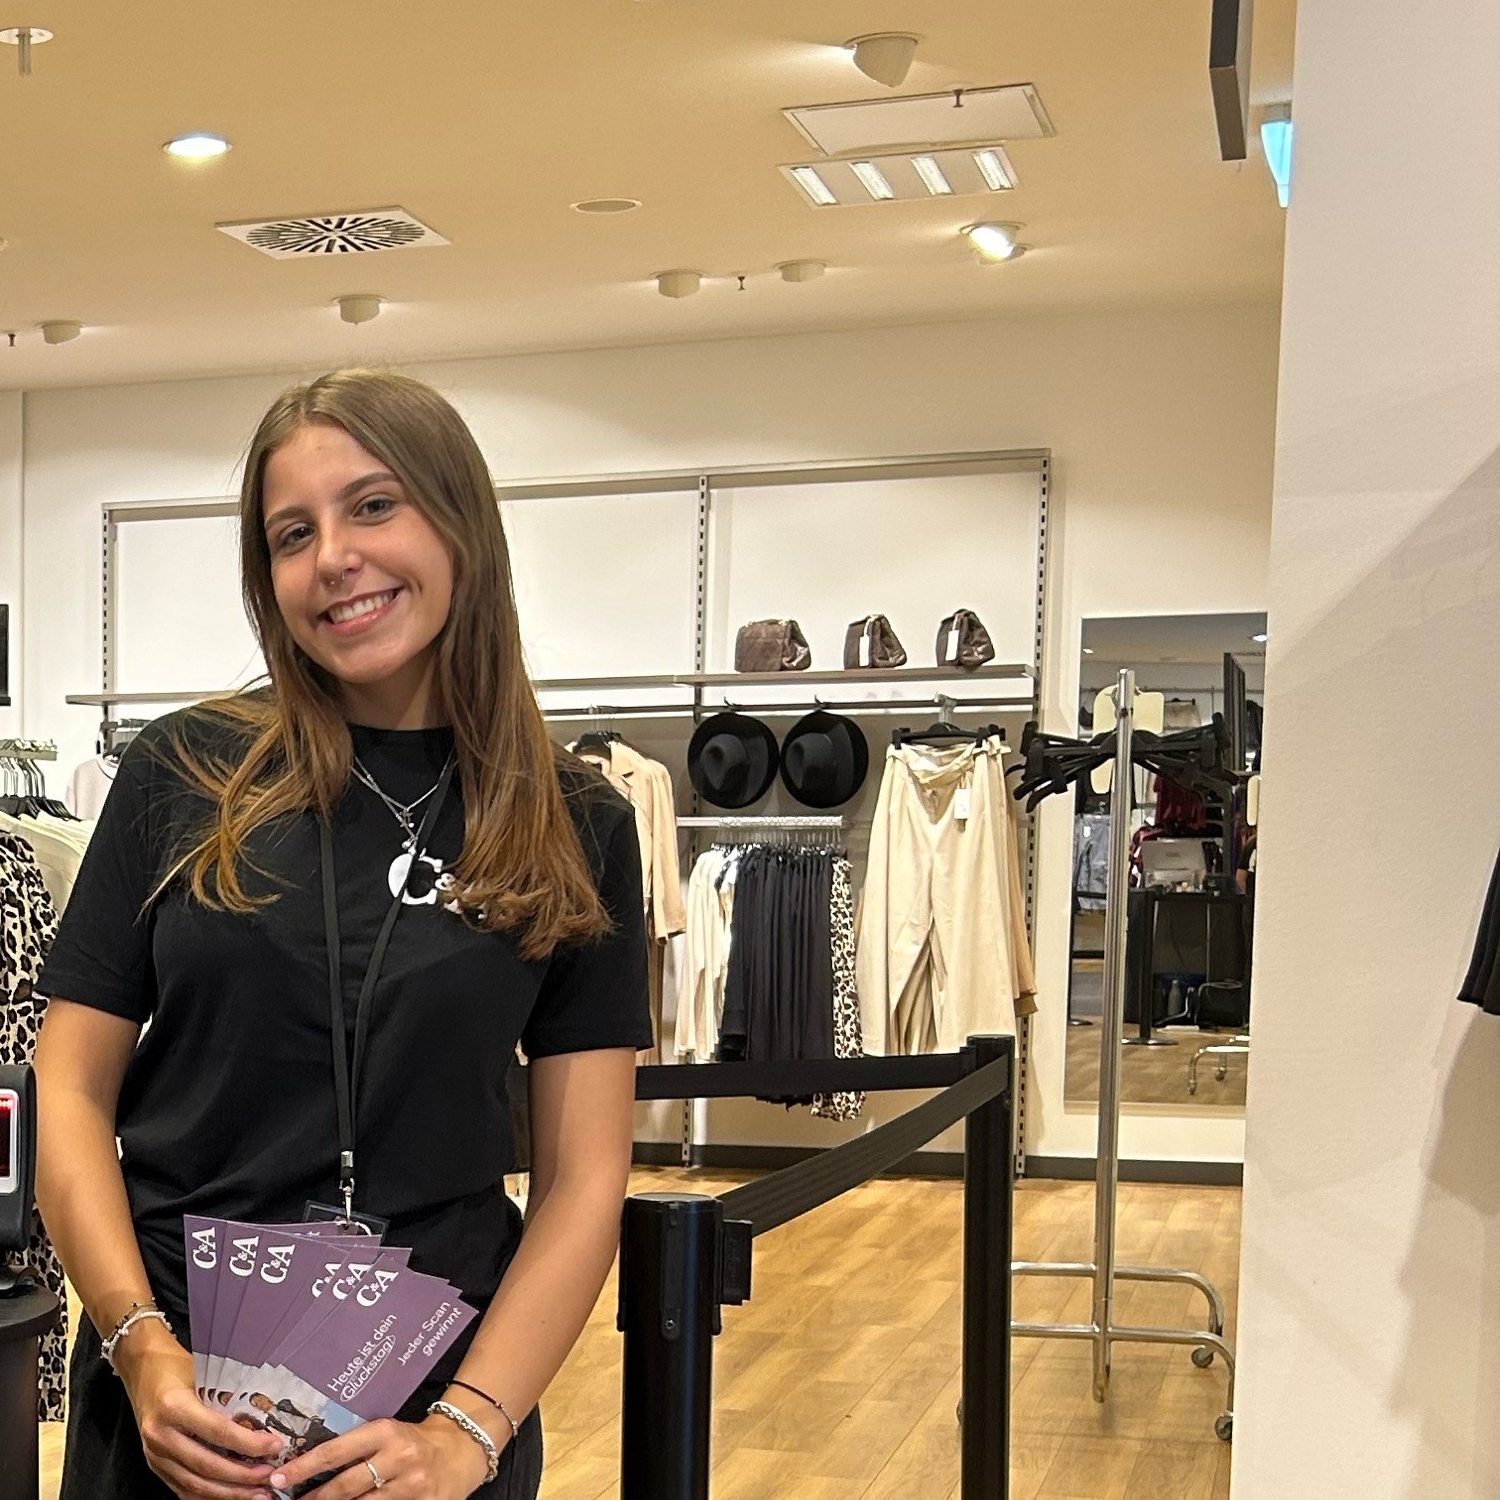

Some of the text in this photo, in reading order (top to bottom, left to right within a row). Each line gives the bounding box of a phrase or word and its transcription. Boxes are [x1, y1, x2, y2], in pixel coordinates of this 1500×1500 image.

[192, 1227, 216, 1269] C&A
[229, 1235, 259, 1277] C&A
[260, 1243, 295, 1284] C&A
[356, 1269, 399, 1307] C&A
[327, 1314, 397, 1392] Heute ist dein
[398, 1301, 451, 1366] Jeder Scan
[422, 1307, 462, 1357] gewinnt
